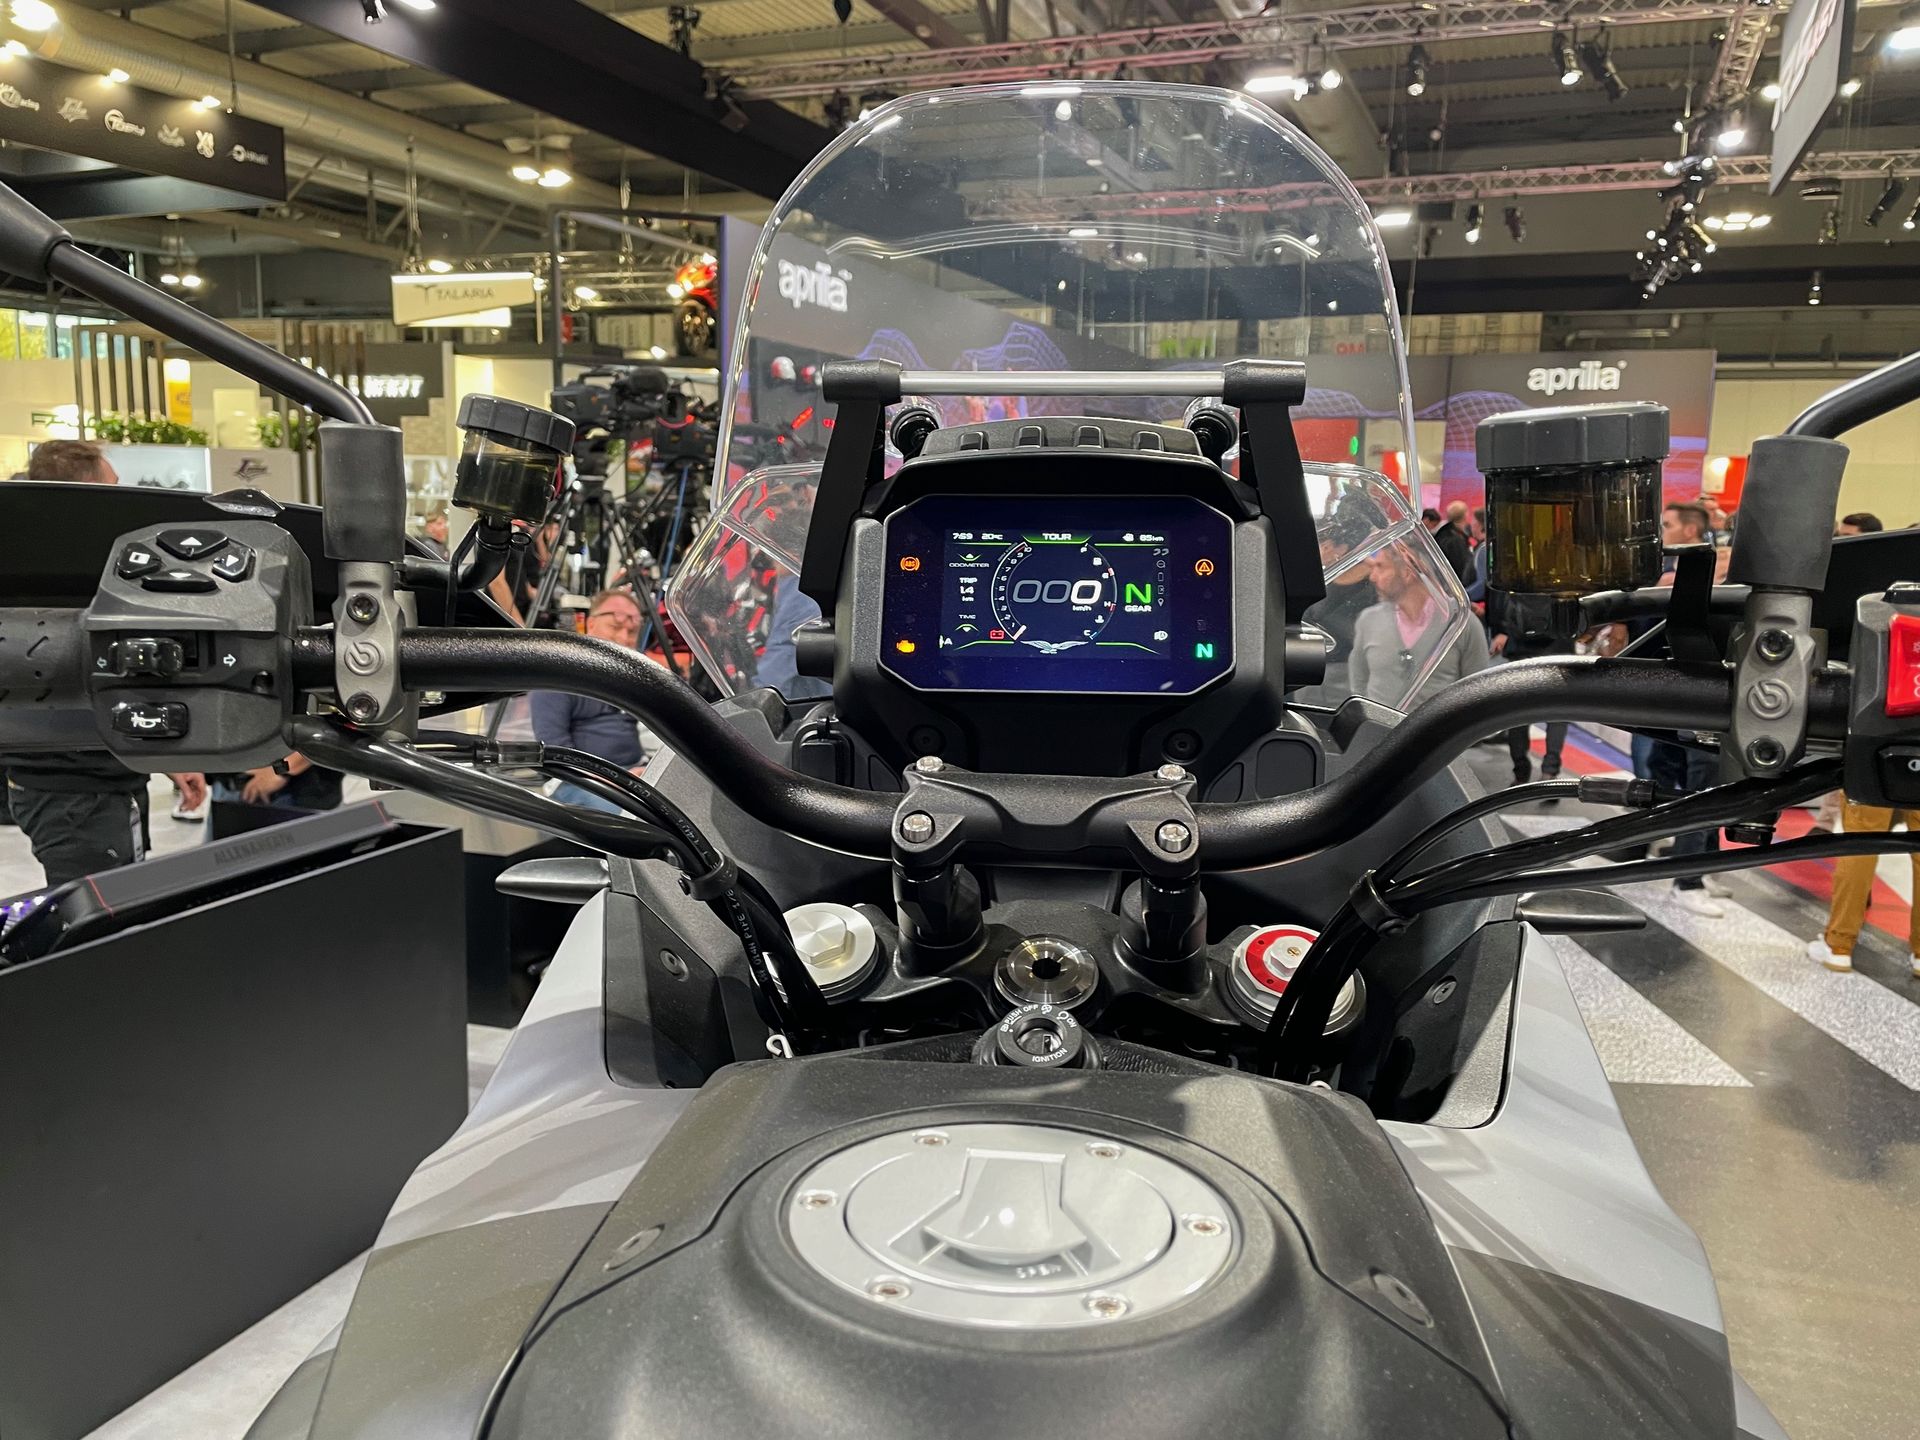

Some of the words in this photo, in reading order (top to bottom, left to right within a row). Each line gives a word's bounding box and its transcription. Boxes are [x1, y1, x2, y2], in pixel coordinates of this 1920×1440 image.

[1527, 360, 1621, 396] aprilia
[1042, 532, 1072, 541] TOUR
[1125, 583, 1152, 604] N
[1196, 643, 1213, 658] N
[1005, 1009, 1022, 1024] PUSH
[1023, 1004, 1039, 1012] OFF
[1066, 1017, 1077, 1028] ON
[1032, 1047, 1068, 1063] IGNITION
